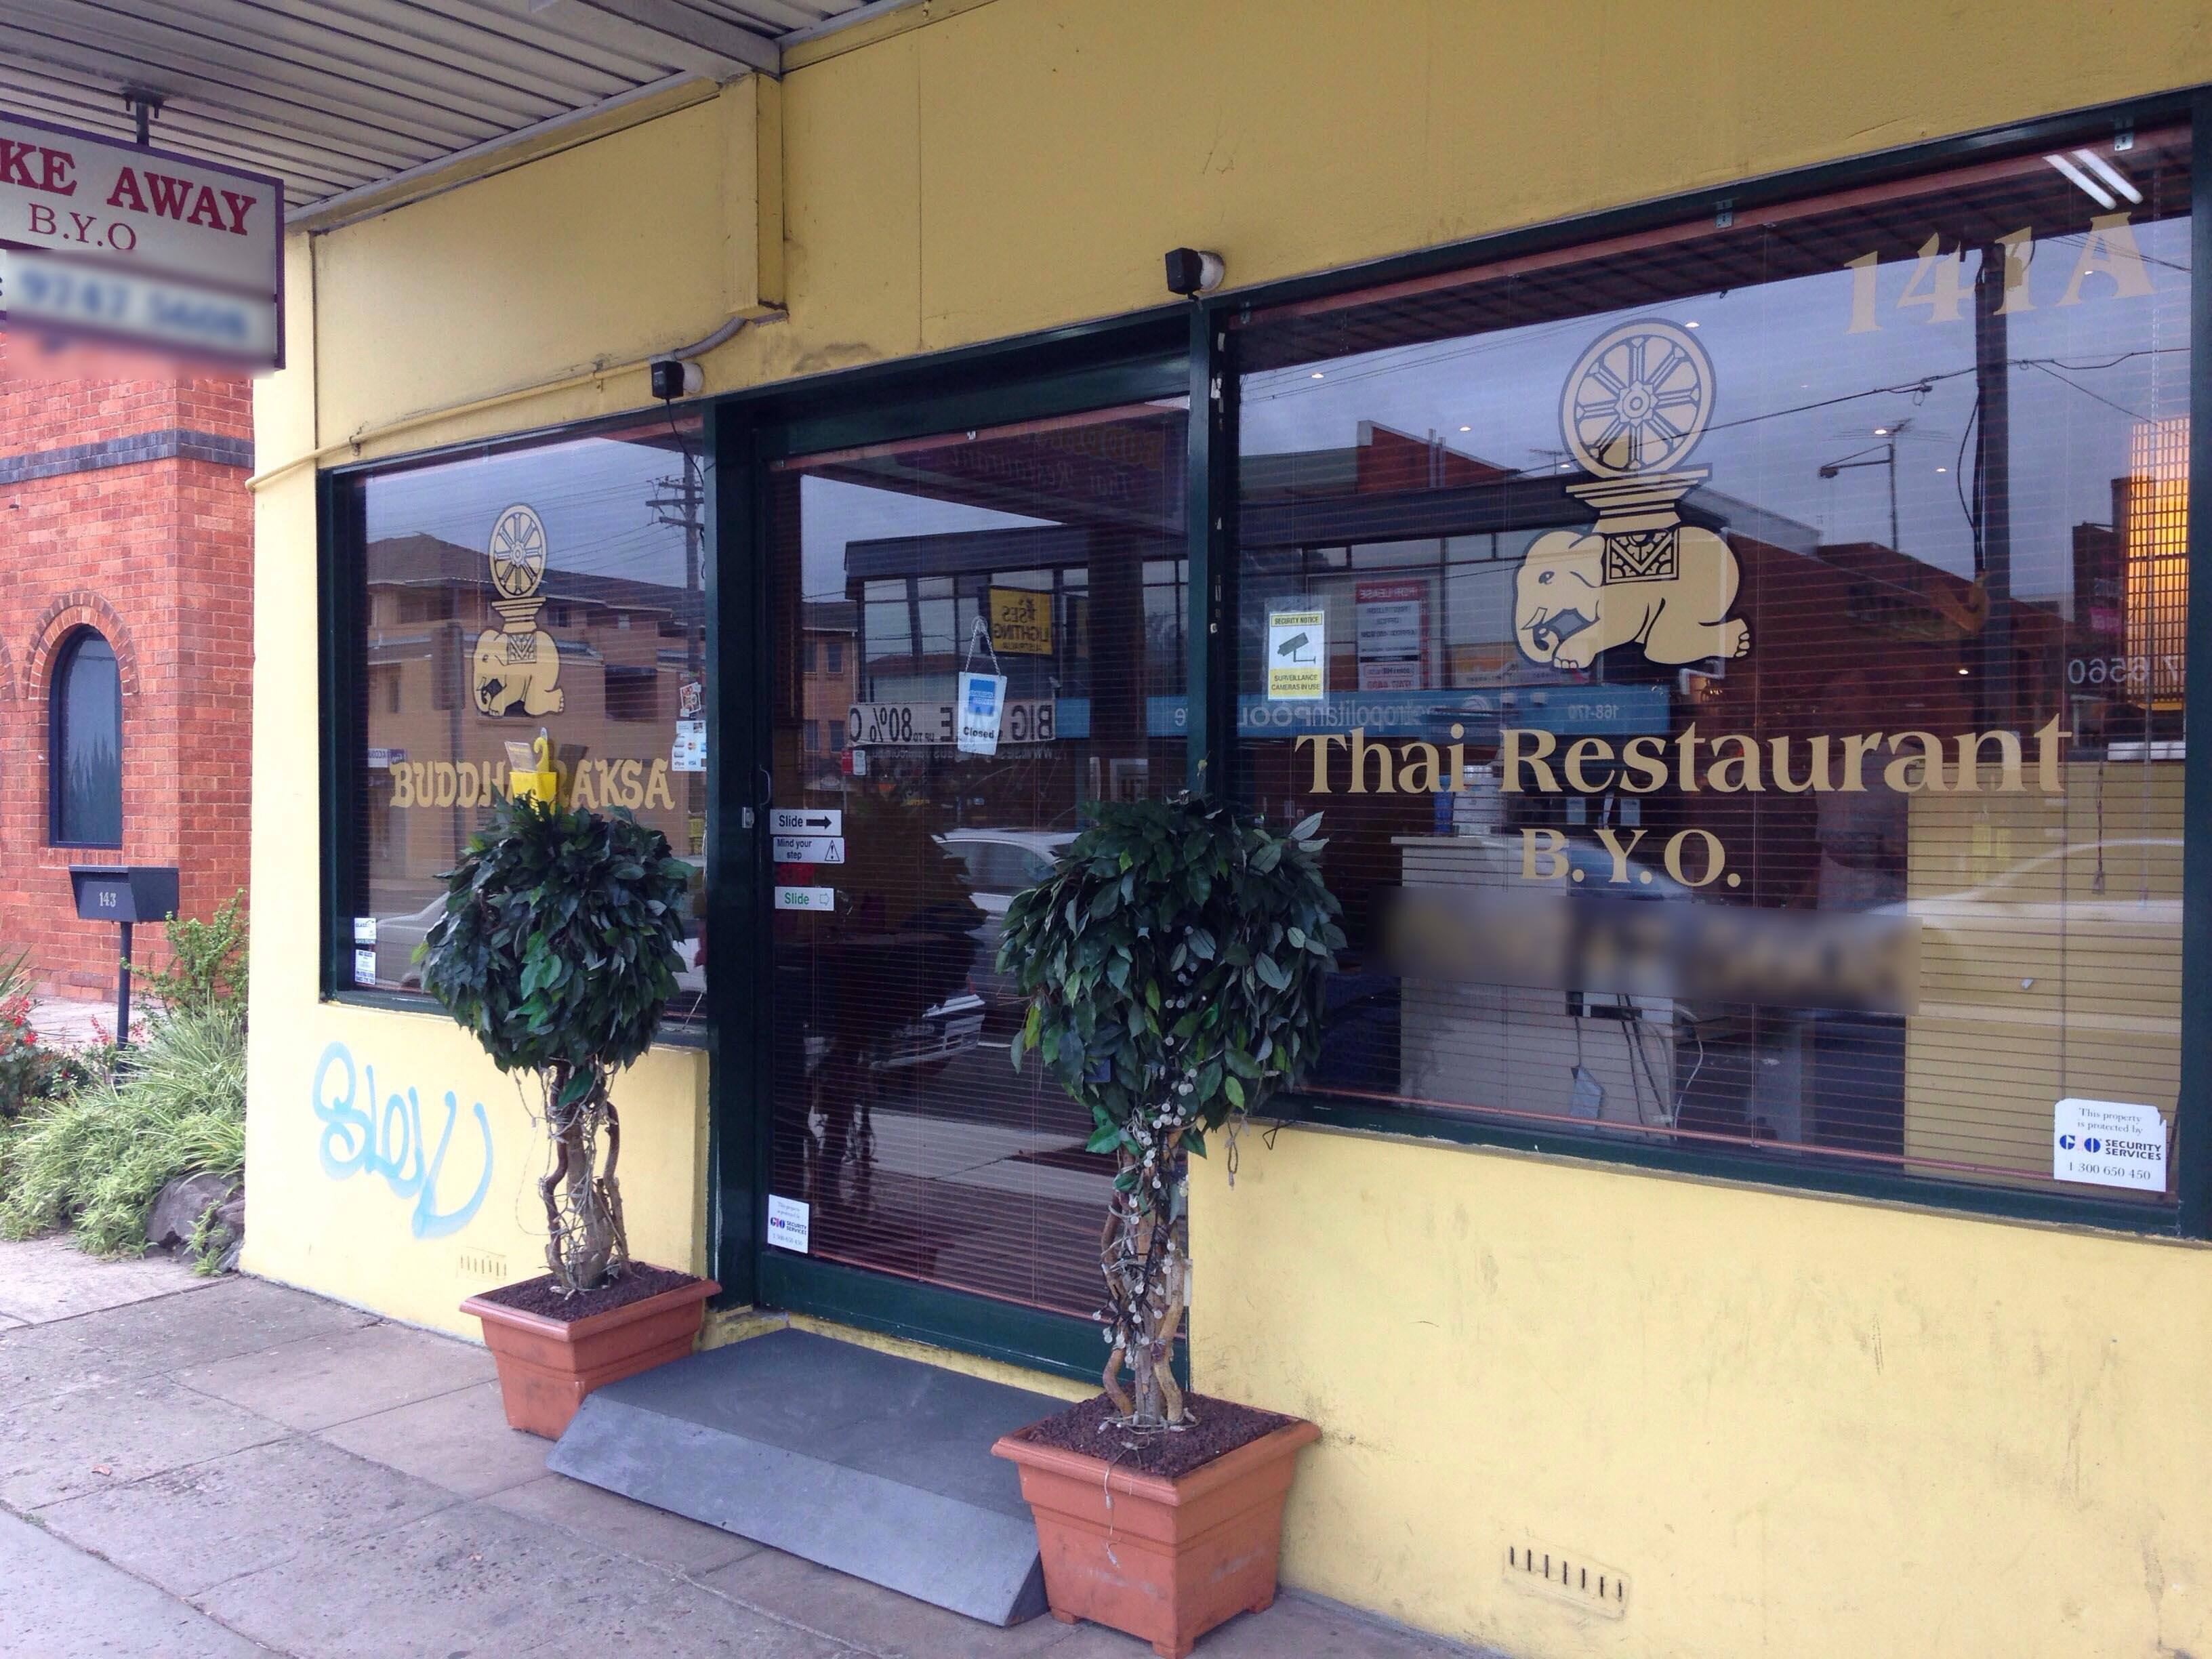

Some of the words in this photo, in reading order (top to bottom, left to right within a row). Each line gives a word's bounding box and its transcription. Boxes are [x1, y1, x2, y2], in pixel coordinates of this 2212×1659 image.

[106, 167, 256, 236] AWAY
[28, 203, 136, 250] B.Y.O
[1275, 617, 1298, 625] SECURITY
[1300, 616, 1319, 624] NOTICE
[1274, 674, 1318, 682] SURVEILLANCE
[964, 726, 995, 739] Closed
[1294, 723, 1469, 794] Thai
[1498, 714, 2072, 794] Restaurant
[779, 815, 803, 827] Slide
[777, 839, 794, 848] Mind
[796, 840, 813, 850] your
[787, 851, 802, 861] step
[1520, 828, 1741, 888] B.Y.O.
[99, 892, 117, 907] 143
[785, 892, 810, 905] Slide
[2078, 1107, 2101, 1118] This
[2103, 1112, 2142, 1123] property
[2087, 1123, 2129, 1134] protected
[2132, 1126, 2143, 1136] by
[2105, 1139, 2162, 1152] SECURITY
[2105, 1147, 2162, 1161] SERVICES
[2078, 1164, 2100, 1174] 300
[2104, 1167, 2125, 1178] 650
[2129, 1169, 2150, 1181] 450
